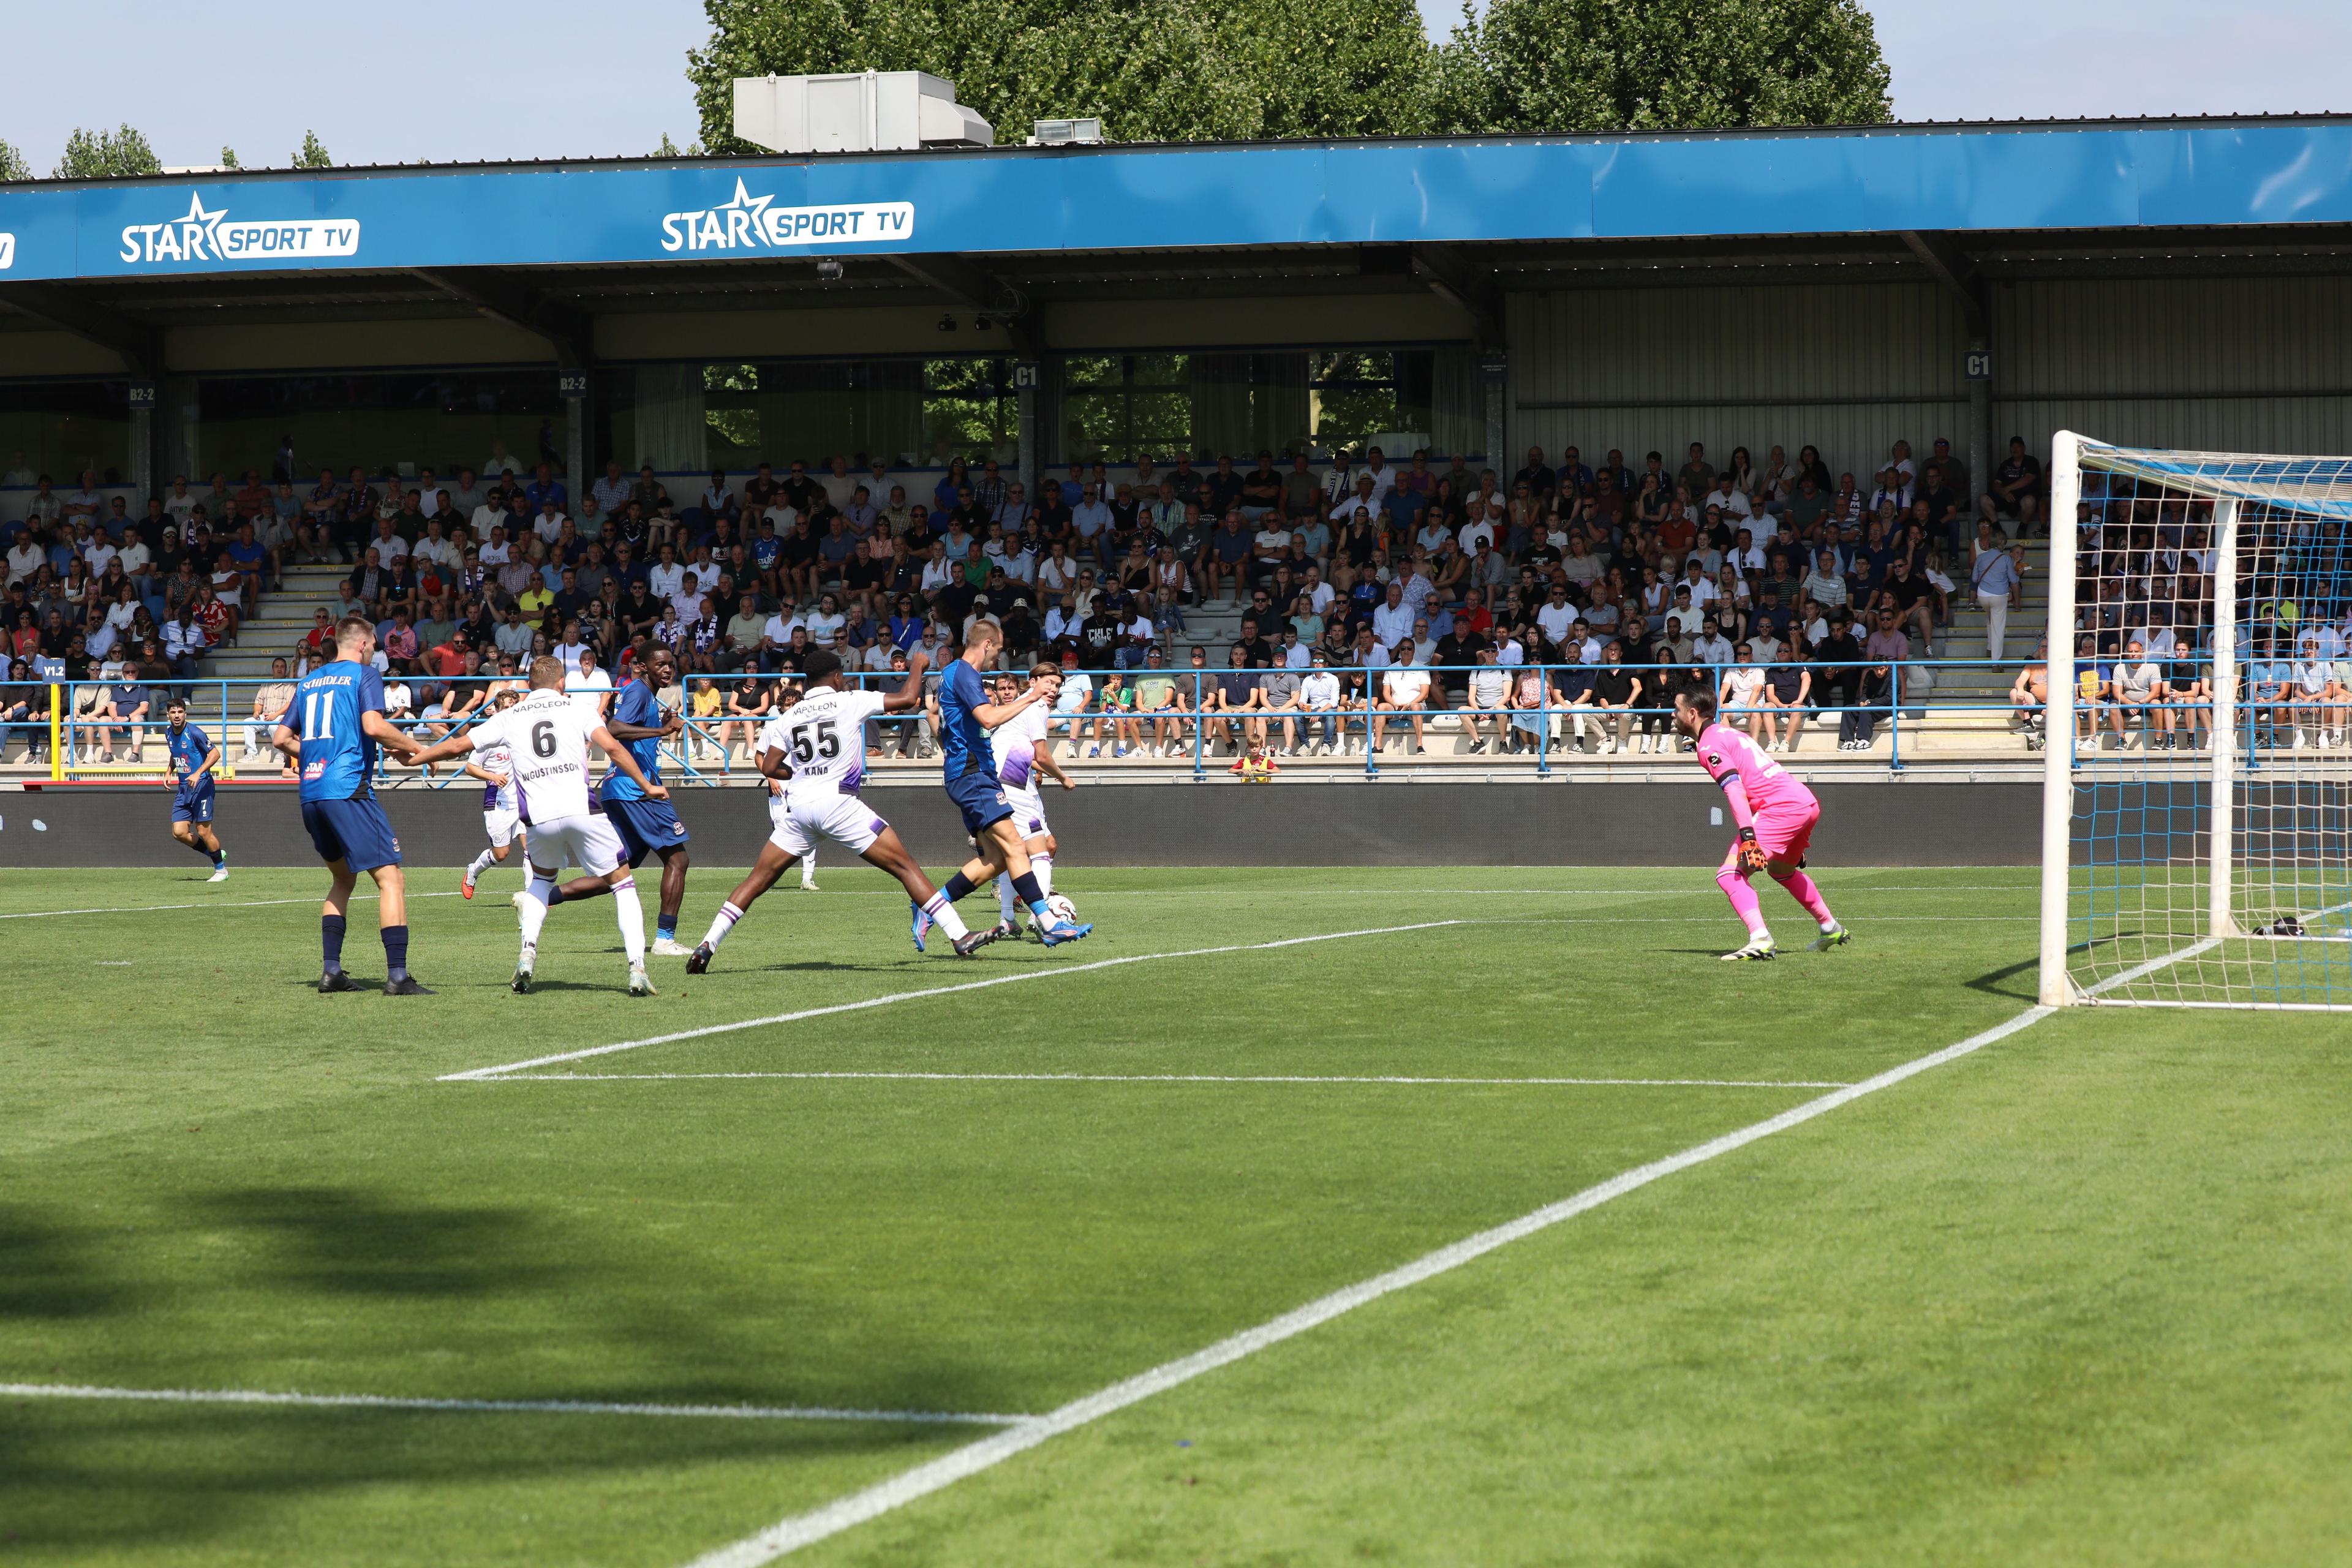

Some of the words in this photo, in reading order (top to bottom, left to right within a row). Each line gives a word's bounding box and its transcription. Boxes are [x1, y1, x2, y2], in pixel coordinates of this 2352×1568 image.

[661, 209, 756, 251] STAR
[776, 211, 864, 238] SPORT
[876, 211, 907, 230] TV
[120, 222, 209, 263] STAR
[228, 227, 313, 251] SPORT
[324, 227, 352, 246] TV
[1967, 355, 1989, 375] C1
[1016, 366, 1036, 386] C1
[560, 377, 586, 390] B2-2
[130, 388, 154, 401] B2-2
[44, 666, 64, 677] V1.2
[513, 701, 570, 714] NAPOLEON
[793, 701, 837, 717] NAPOLEON
[302, 690, 334, 742] 11
[531, 720, 557, 758] 6
[791, 720, 840, 763] 55
[172, 757, 188, 766] TAR
[305, 762, 324, 772] STAR
[804, 766, 829, 776] KANA
[200, 799, 207, 810] 7
